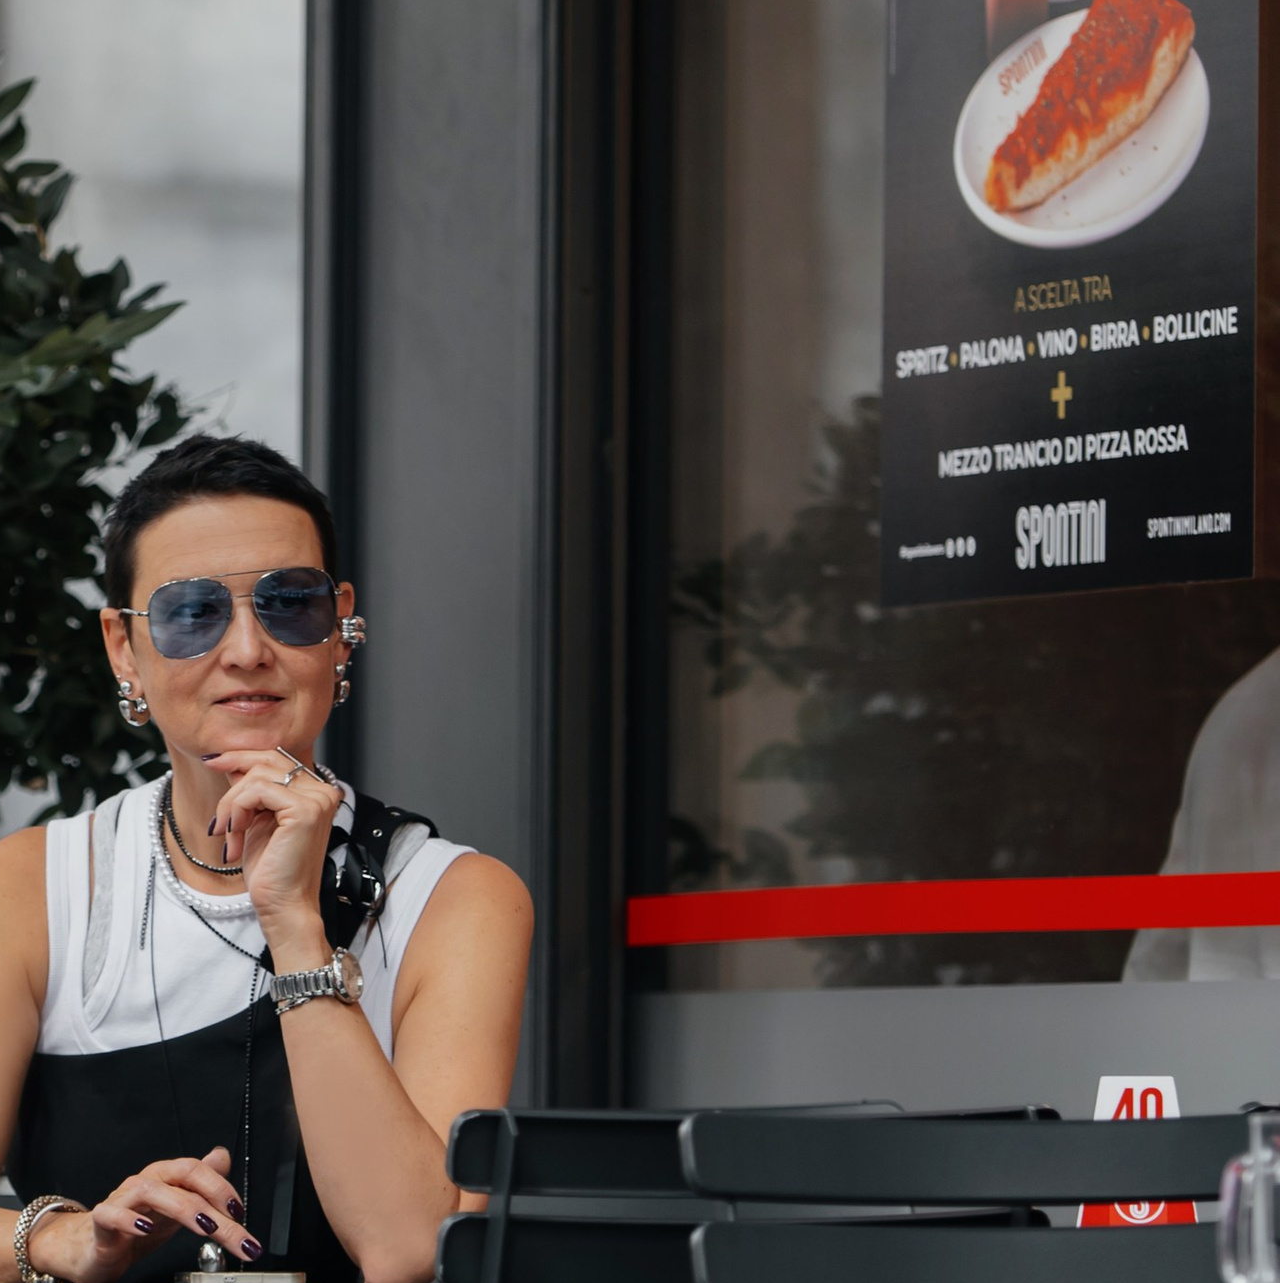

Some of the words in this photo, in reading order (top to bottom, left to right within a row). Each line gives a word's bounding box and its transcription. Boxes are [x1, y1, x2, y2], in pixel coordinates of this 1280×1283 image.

[1013, 287, 1027, 314] A
[1028, 279, 1080, 312] SCELTA
[1082, 274, 1113, 303] TRA
[895, 344, 950, 379] SPRITZ
[959, 335, 1026, 370] PALOMA
[1036, 327, 1078, 359] VINO
[1090, 319, 1140, 352] BIRRA
[1152, 306, 1239, 344] BOLLICINE
[938, 447, 993, 479] MEZZO
[994, 438, 1061, 473] TRANCIO
[1065, 434, 1083, 464] DI
[1085, 429, 1132, 461] PIZZA
[1135, 424, 1189, 456] ROSSA
[1015, 499, 1107, 571] SPONTINI
